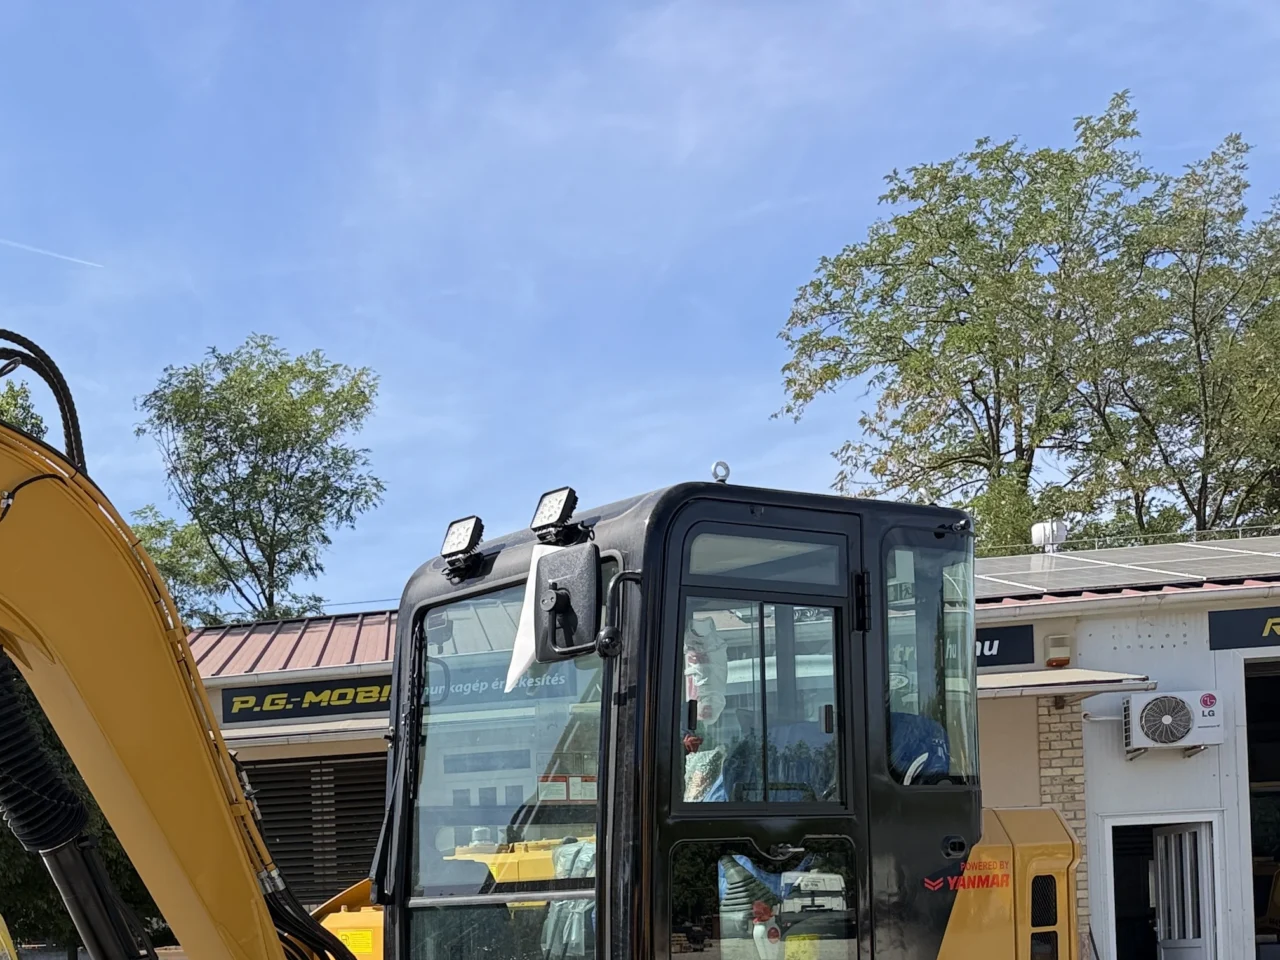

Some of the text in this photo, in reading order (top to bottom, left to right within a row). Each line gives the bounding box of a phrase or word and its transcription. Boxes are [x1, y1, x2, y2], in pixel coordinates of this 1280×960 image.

[491, 674, 566, 691] érkesítés
[231, 684, 394, 714] P.G.-MOBI
[960, 860, 1009, 872] POWERED BY
[947, 873, 1010, 891] YANMAR
